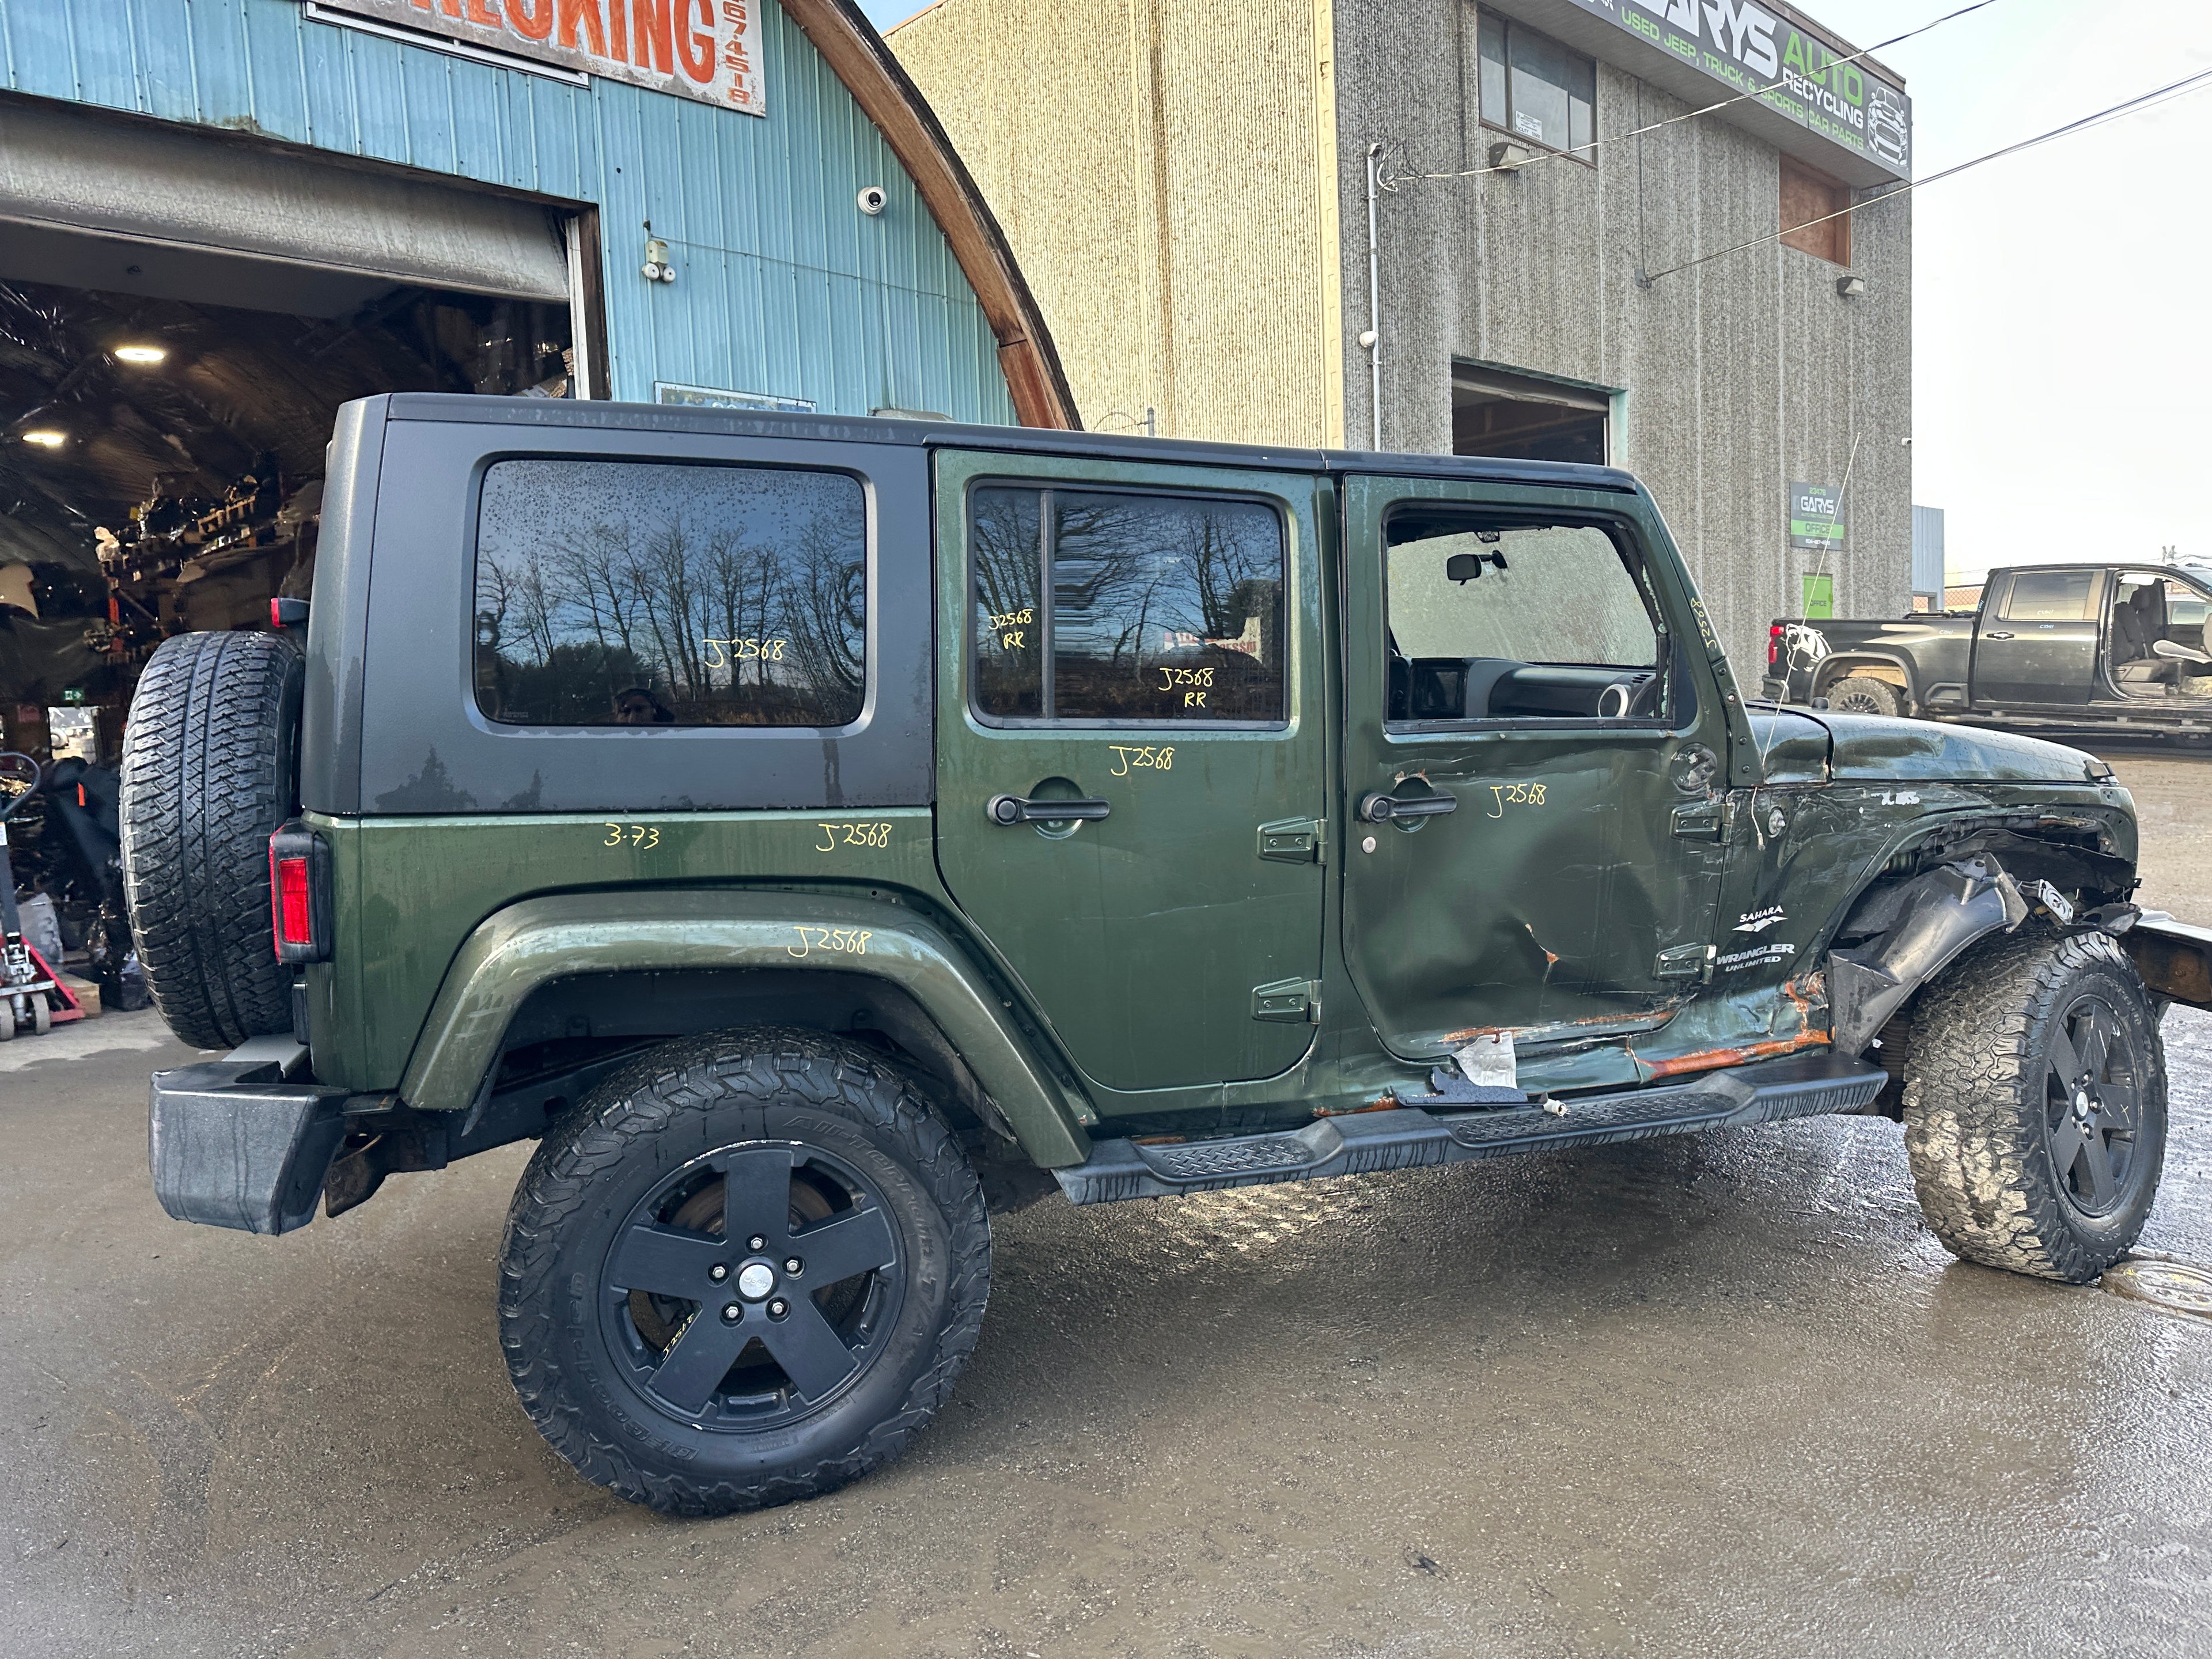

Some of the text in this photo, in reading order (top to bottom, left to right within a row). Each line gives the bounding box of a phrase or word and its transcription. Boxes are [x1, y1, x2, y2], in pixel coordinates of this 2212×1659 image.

[1622, 6, 1864, 150] USED JEEP, TRUCK & SPORTS CAR PARTS
[1783, 31, 1863, 107] AUTO
[1782, 66, 1863, 129] RECYCLING
[1801, 496, 1834, 514] GARYS
[1805, 522, 1831, 534] OFFICE
[988, 608, 1033, 630] J2568
[1691, 597, 1717, 649] J2568
[702, 639, 787, 668] J2568
[1003, 631, 1025, 650] RR
[1158, 667, 1215, 691] J2568
[1184, 692, 1206, 708] RR
[1109, 745, 1175, 776] J2568
[1487, 782, 1547, 818] J2568
[815, 823, 893, 852] J2568
[1739, 904, 1784, 923] SAHARA
[787, 926, 873, 958] J2568
[1716, 944, 1796, 965] WRANGLER
[1725, 956, 1782, 972] UNLIMITED
